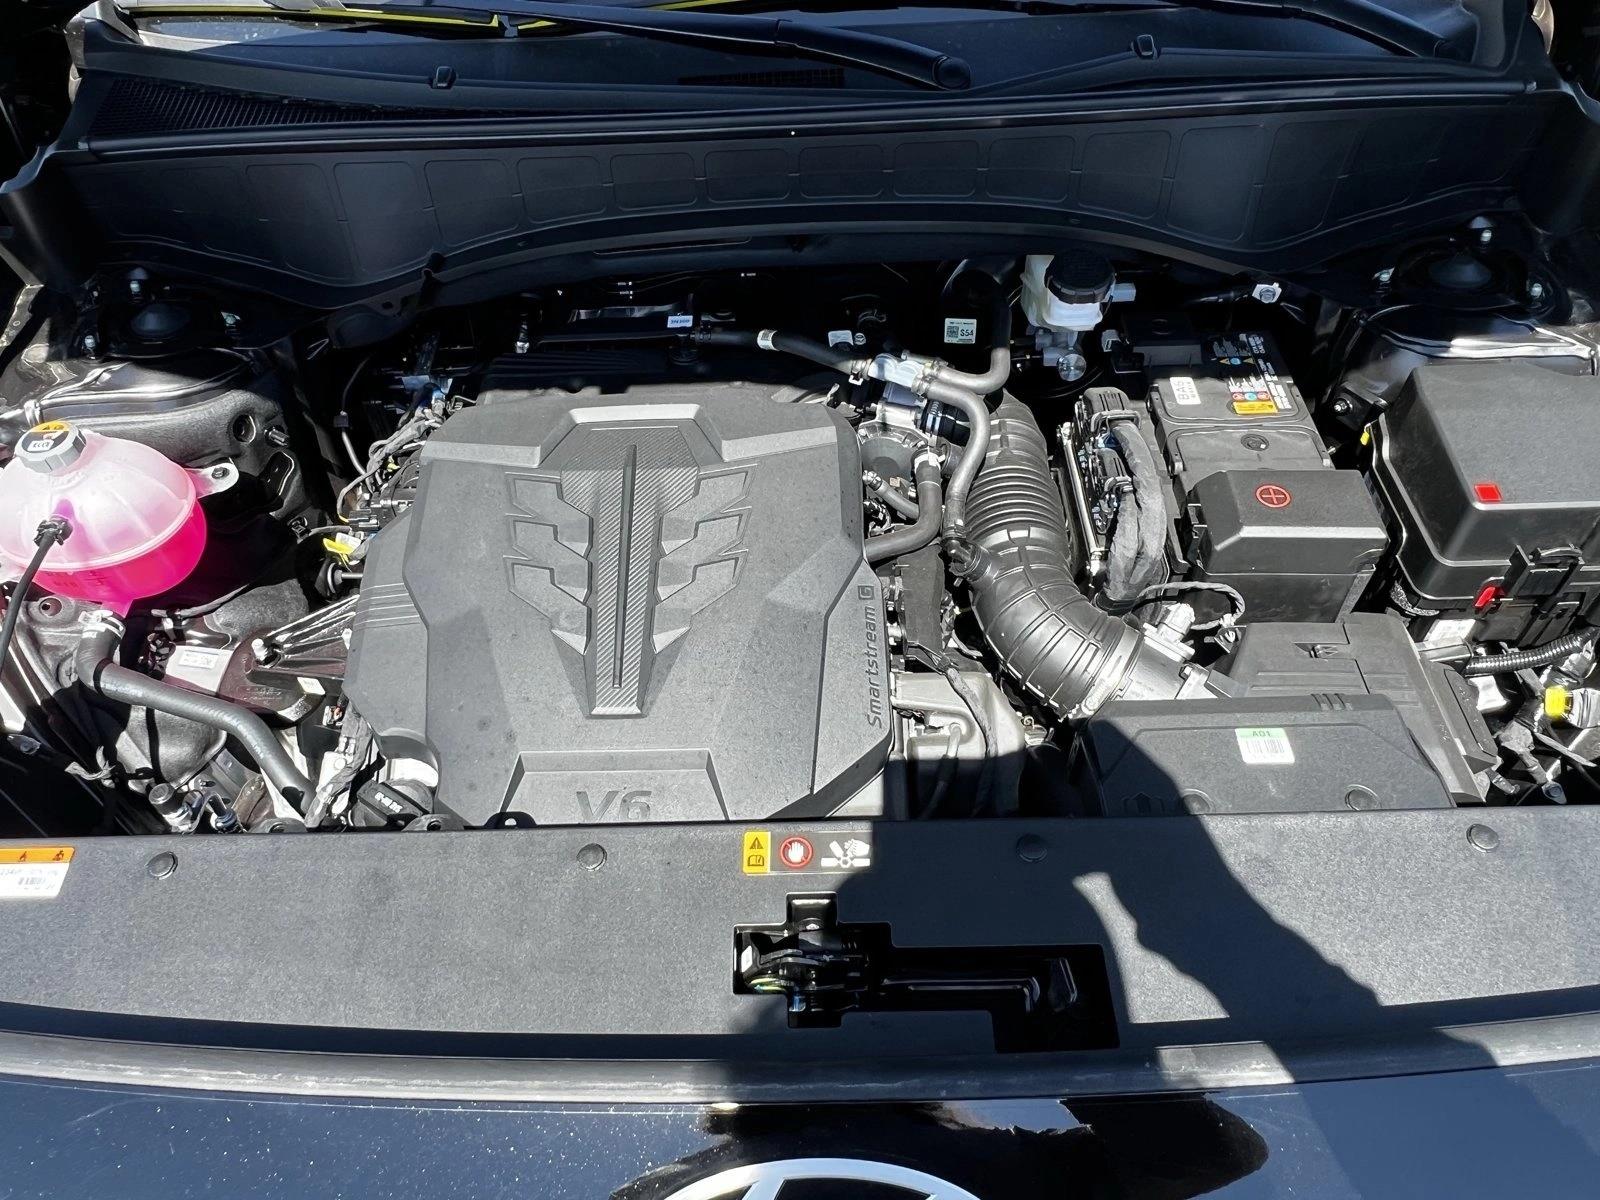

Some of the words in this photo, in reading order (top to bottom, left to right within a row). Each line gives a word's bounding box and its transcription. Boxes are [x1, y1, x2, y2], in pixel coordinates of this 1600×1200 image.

[960, 328, 974, 337] S54
[864, 605, 883, 729] Smartstream
[576, 790, 652, 821] V6
